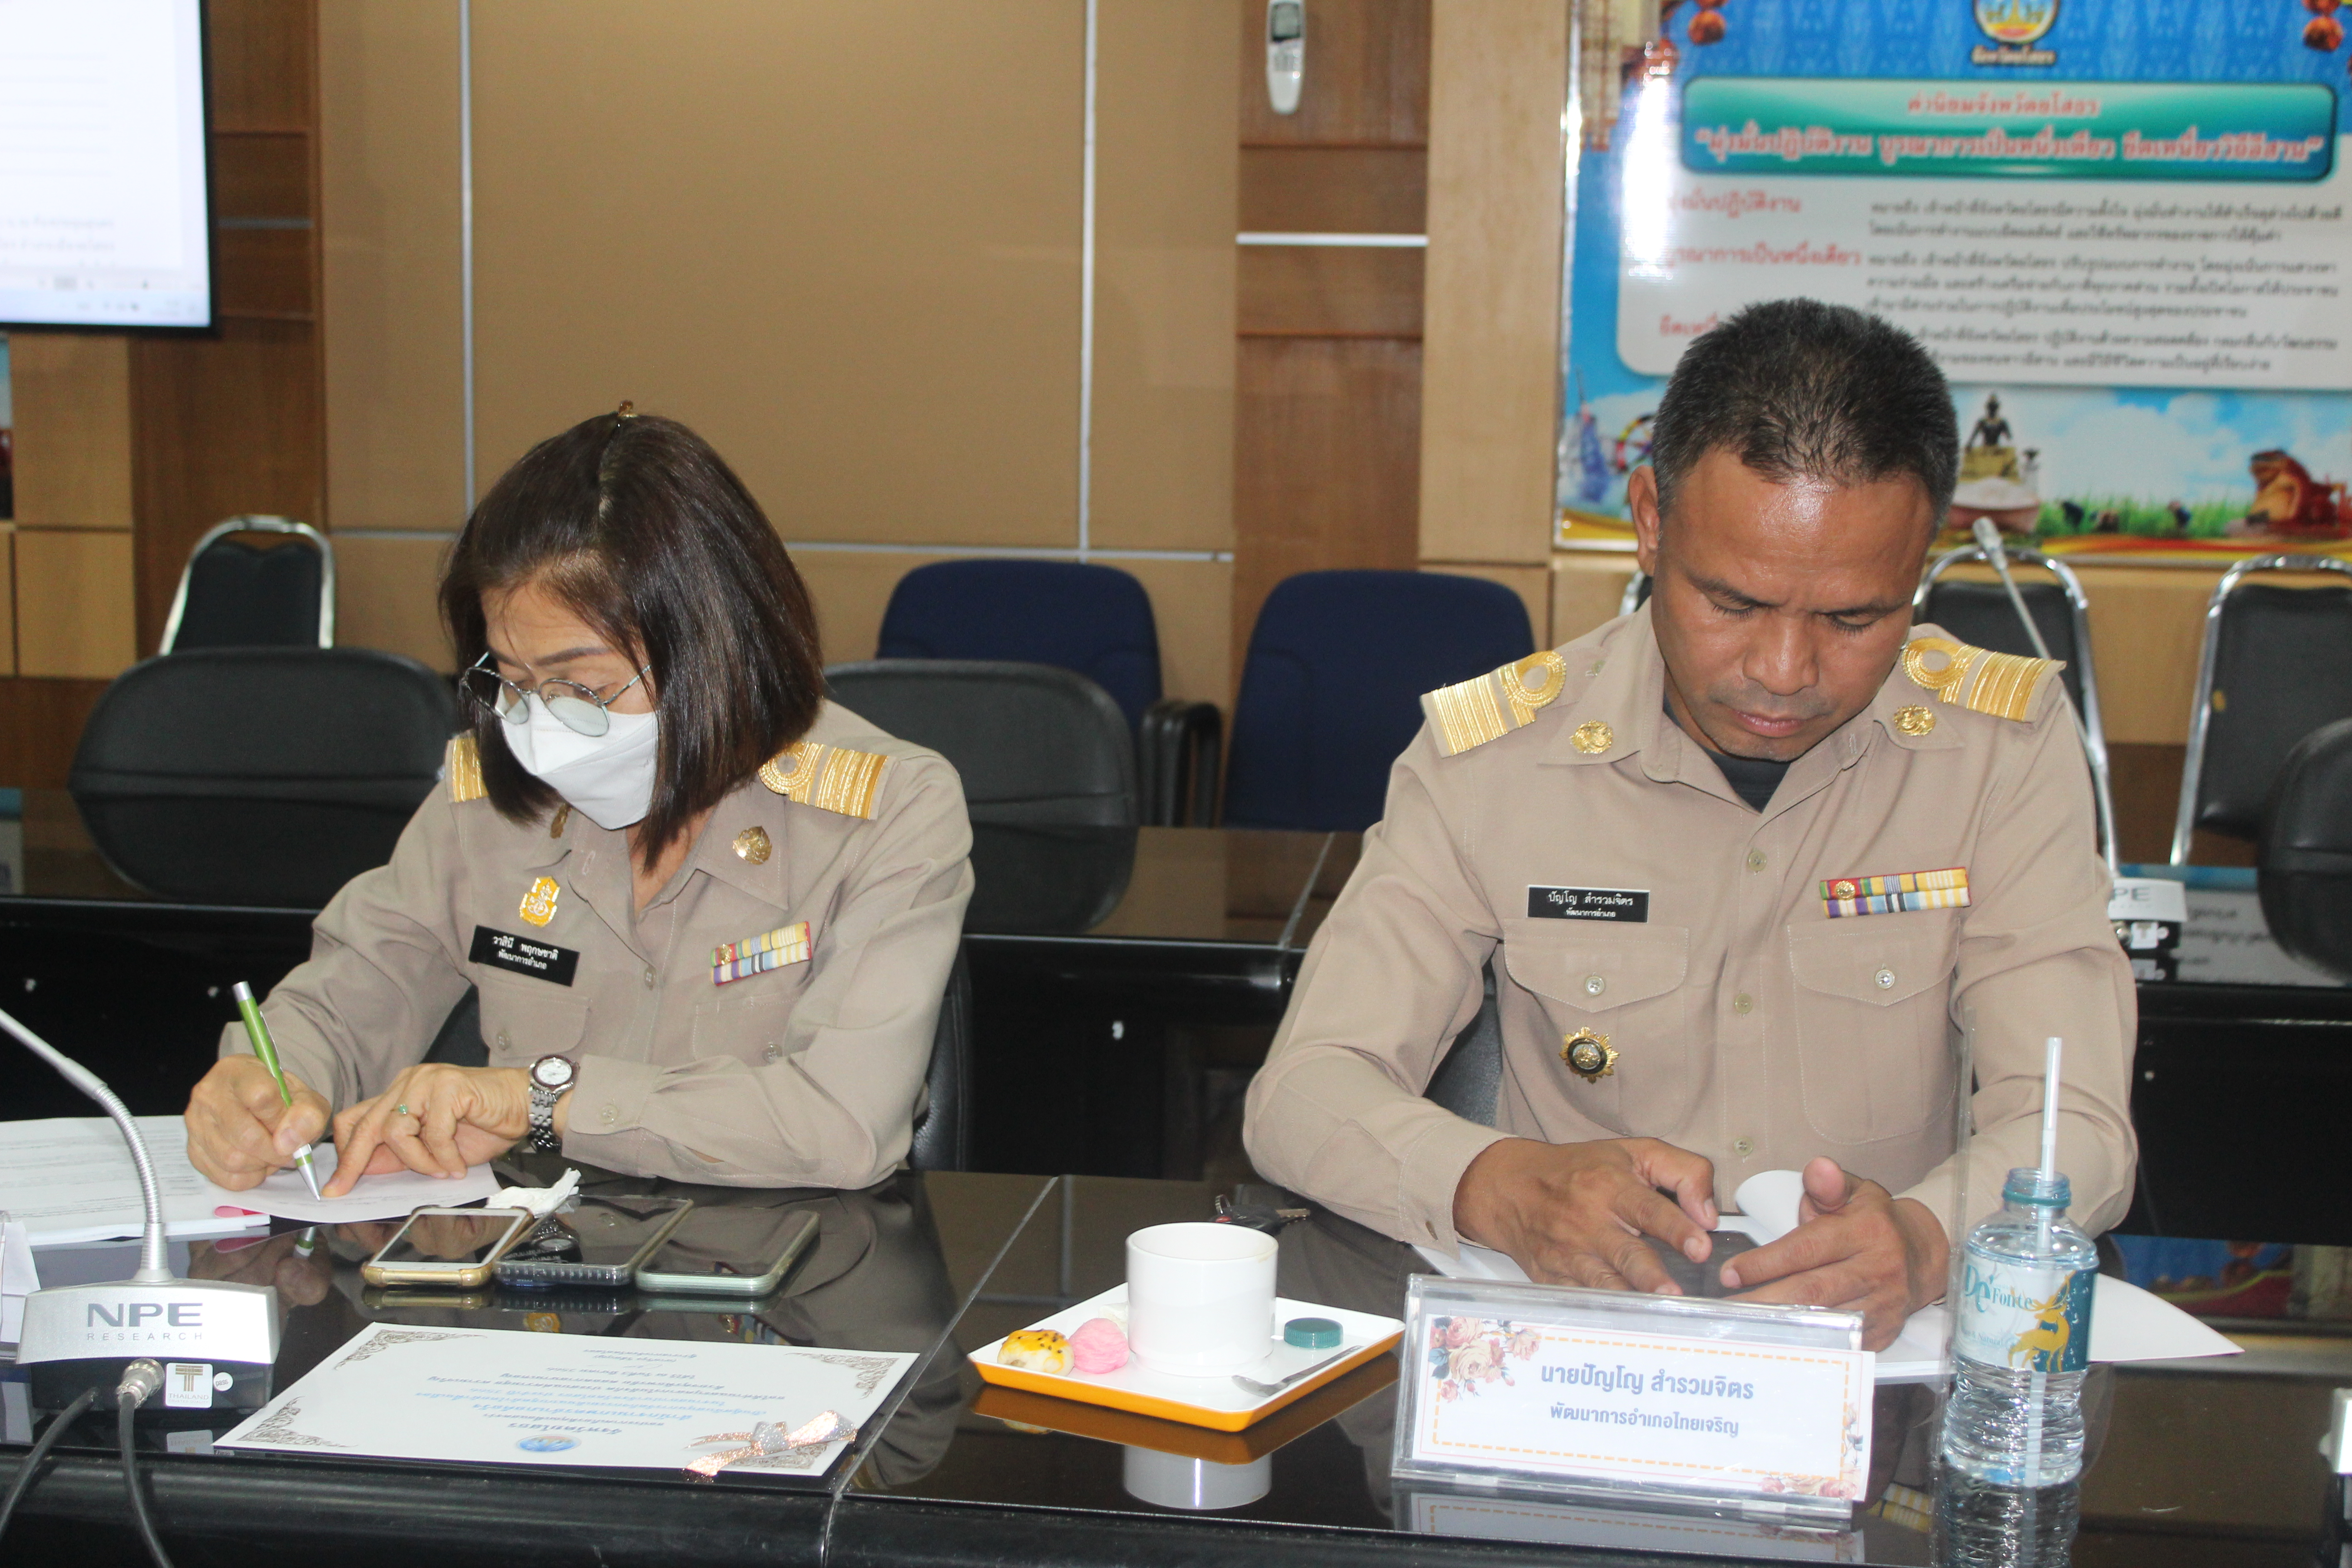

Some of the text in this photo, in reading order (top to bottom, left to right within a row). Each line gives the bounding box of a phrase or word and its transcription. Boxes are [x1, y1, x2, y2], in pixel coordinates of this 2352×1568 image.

[1548, 891, 1633, 906] ปัญโญ สำรวมจิตร
[2111, 887, 2151, 902] PE
[1566, 907, 1616, 917] พัฒนาการอำเภอ
[499, 949, 547, 970] พัฒนาการอำเภอ
[88, 1303, 203, 1328] NPE
[87, 1333, 203, 1341] RESEARCH
[215, 1379, 229, 1387] pass
[1541, 1363, 1754, 1399] นายปัญโญ สำรวมจิตร
[1550, 1401, 1739, 1438] พัฒนาการอำเภอไทยเจริญ
